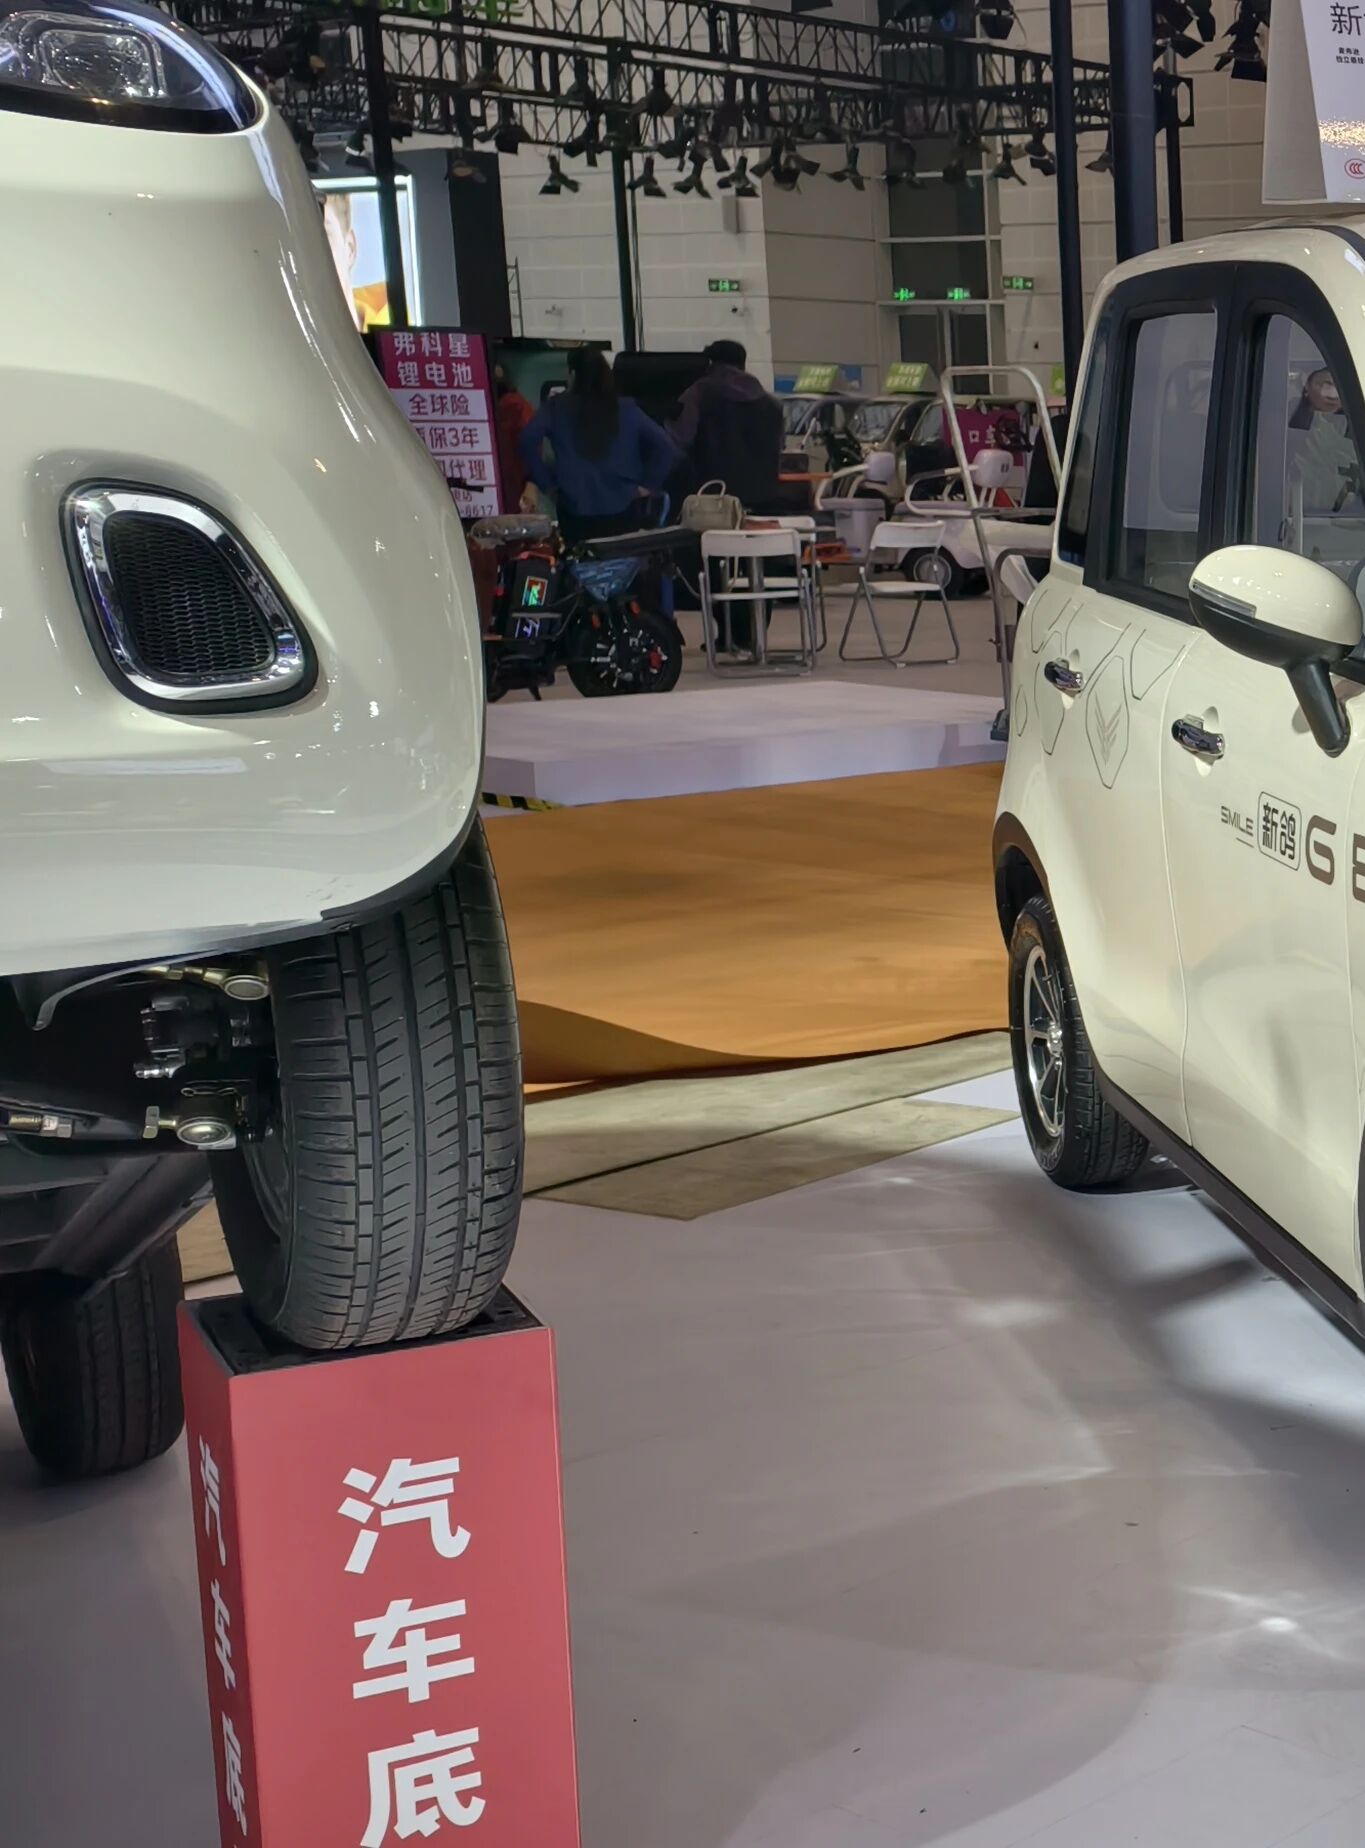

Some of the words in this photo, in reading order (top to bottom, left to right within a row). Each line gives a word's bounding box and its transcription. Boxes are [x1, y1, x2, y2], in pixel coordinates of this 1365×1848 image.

[393, 332, 471, 358] 弗科星
[397, 361, 474, 388] 锂电池
[409, 393, 470, 416] 全球险
[1221, 806, 1254, 837] SMILE
[1262, 802, 1296, 860] 新鸽
